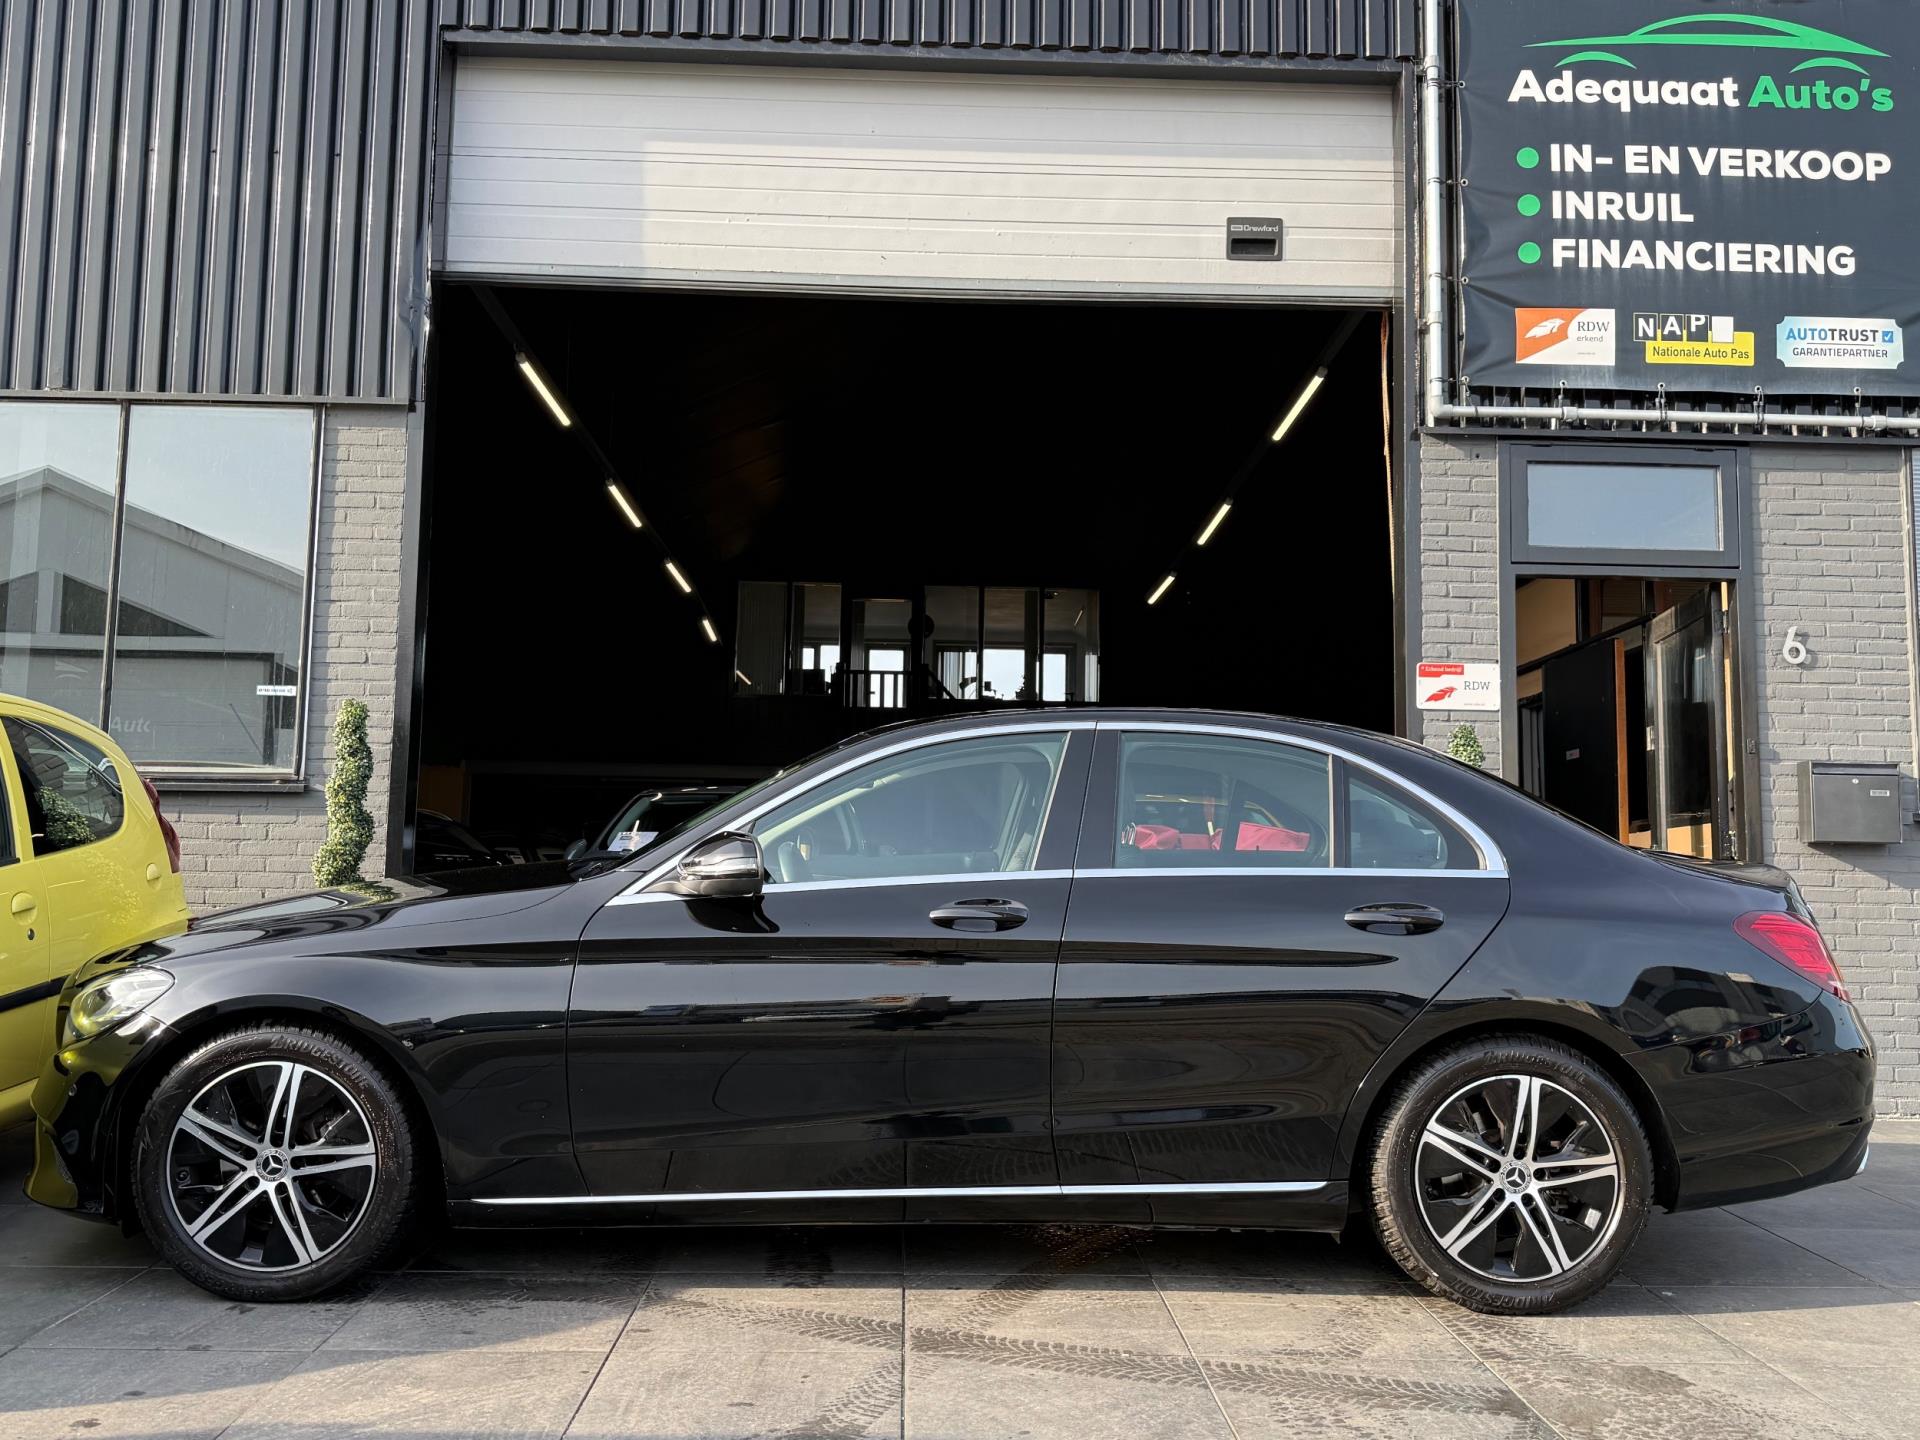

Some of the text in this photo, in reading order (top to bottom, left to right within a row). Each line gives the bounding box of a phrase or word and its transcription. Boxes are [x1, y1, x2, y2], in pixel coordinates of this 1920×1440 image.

[1507, 69, 1894, 112] Adequaat Auto's
[1550, 143, 1892, 182] IN- EN VERKOOP
[1551, 190, 1694, 223] INRUIL
[1552, 238, 1856, 276] FINANCIERING
[1577, 321, 1610, 332] RDW
[1786, 327, 1879, 342] AUTOTRUST
[1652, 346, 1749, 359] Nationale Auto Pas
[1792, 347, 1888, 358] GARANTIEPARTNER
[1782, 625, 1807, 664] 6
[1463, 680, 1491, 690] RDW
